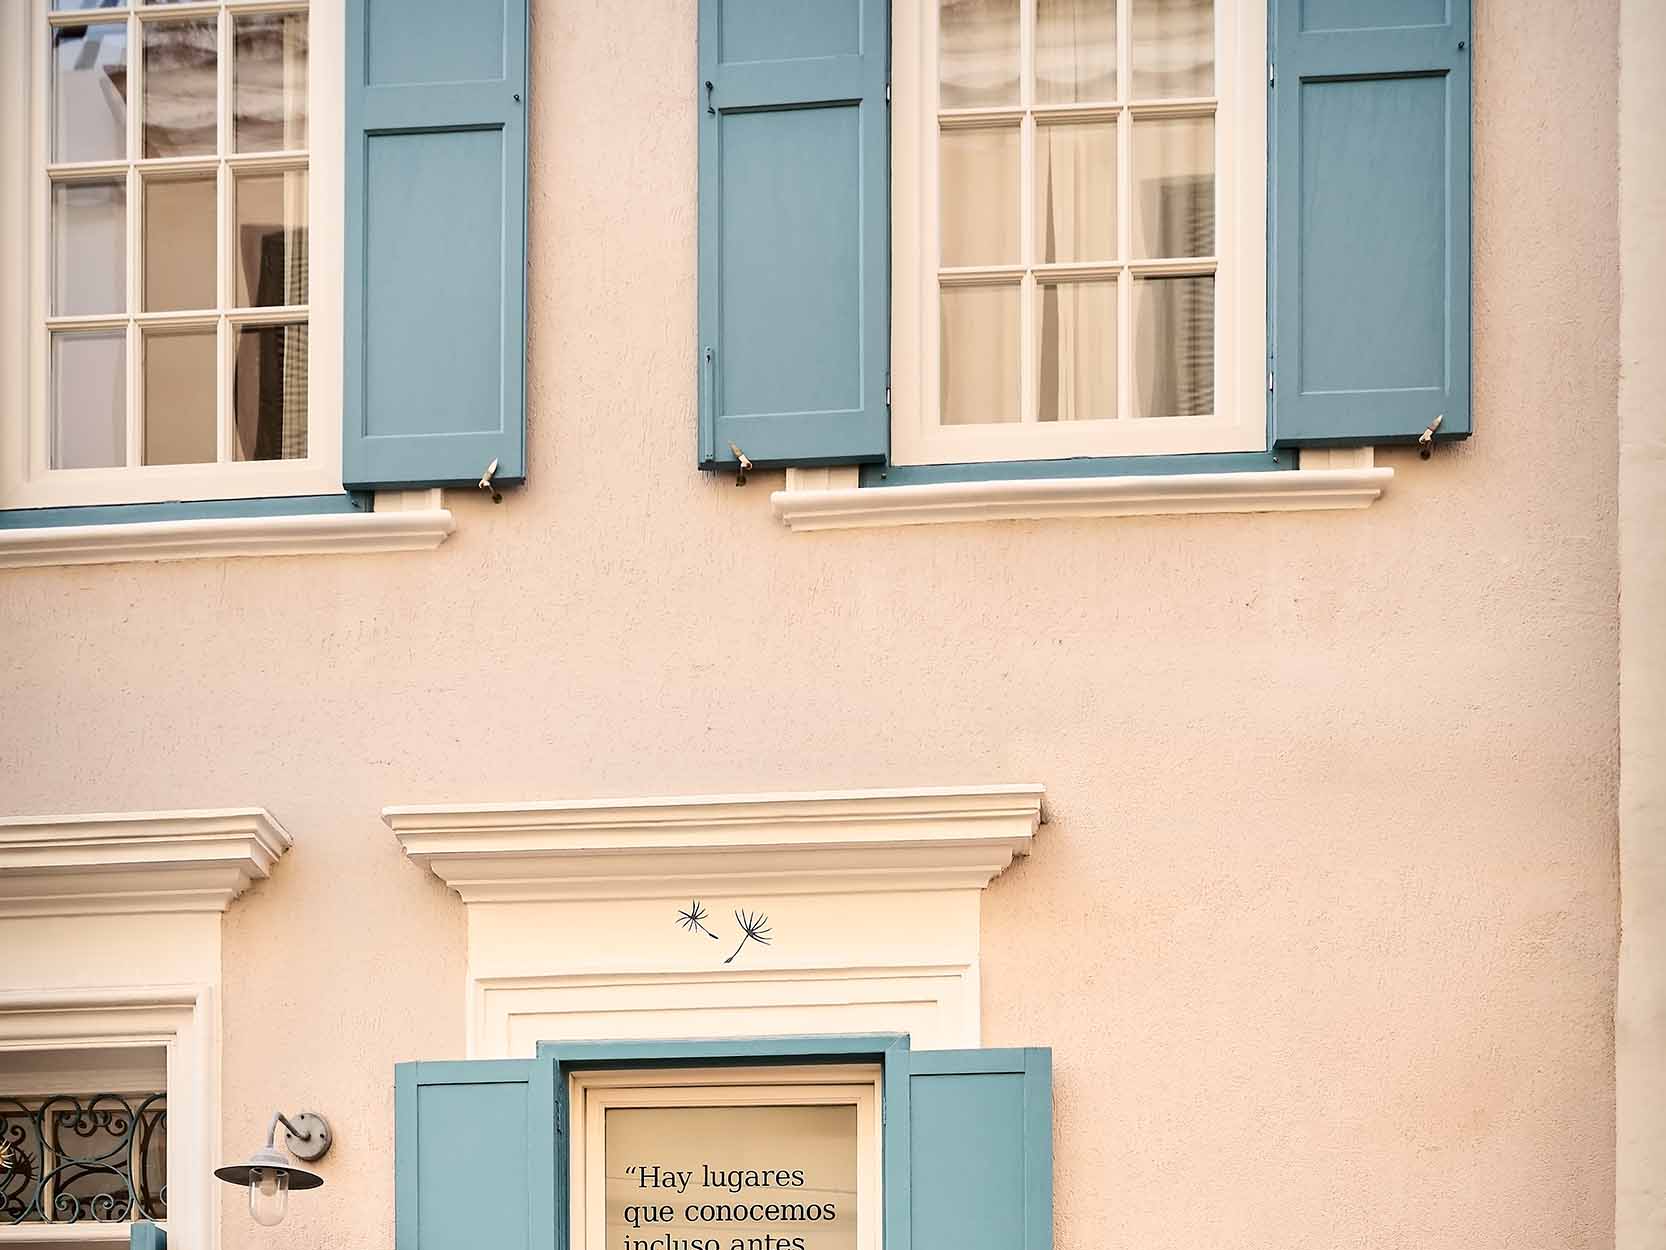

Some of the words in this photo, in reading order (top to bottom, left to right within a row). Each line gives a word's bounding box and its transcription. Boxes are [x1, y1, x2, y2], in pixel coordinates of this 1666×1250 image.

[625, 1165, 693, 1194] “Hay
[702, 1164, 804, 1193] lugares
[624, 1205, 674, 1229] que
[685, 1203, 836, 1222] conocemos
